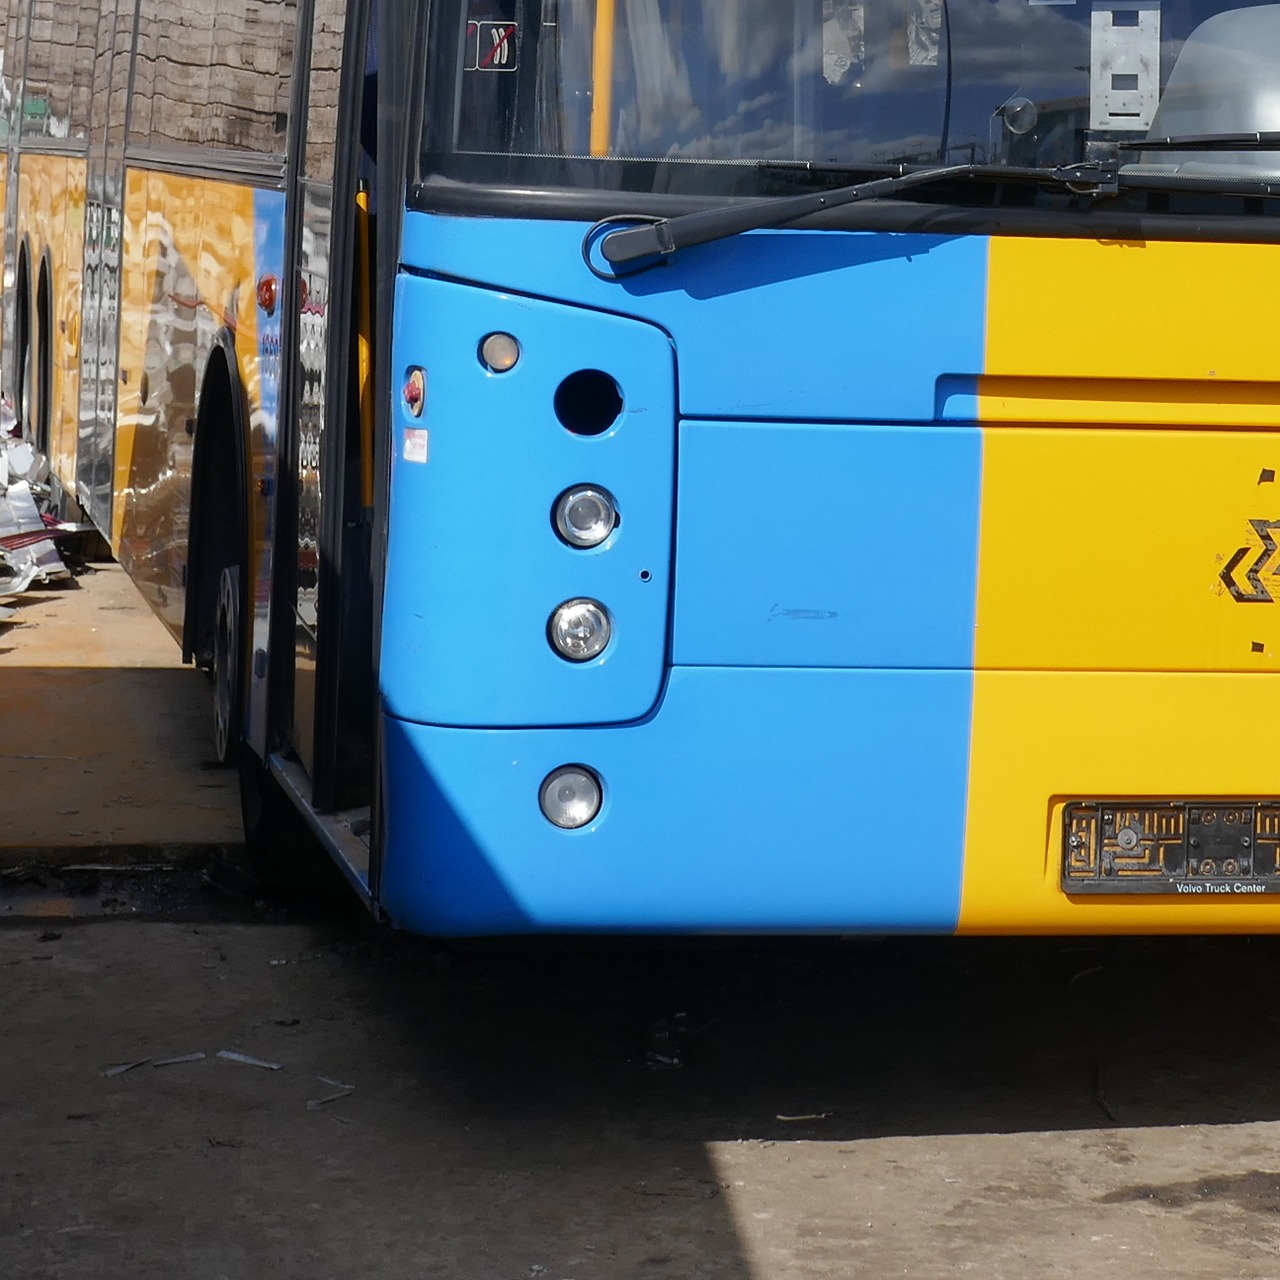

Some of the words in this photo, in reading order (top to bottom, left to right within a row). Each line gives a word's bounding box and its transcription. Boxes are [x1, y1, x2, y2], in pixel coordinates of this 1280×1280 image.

[1176, 883, 1202, 893] Volvo
[1205, 883, 1231, 893] Truck
[1233, 883, 1266, 893] Center
